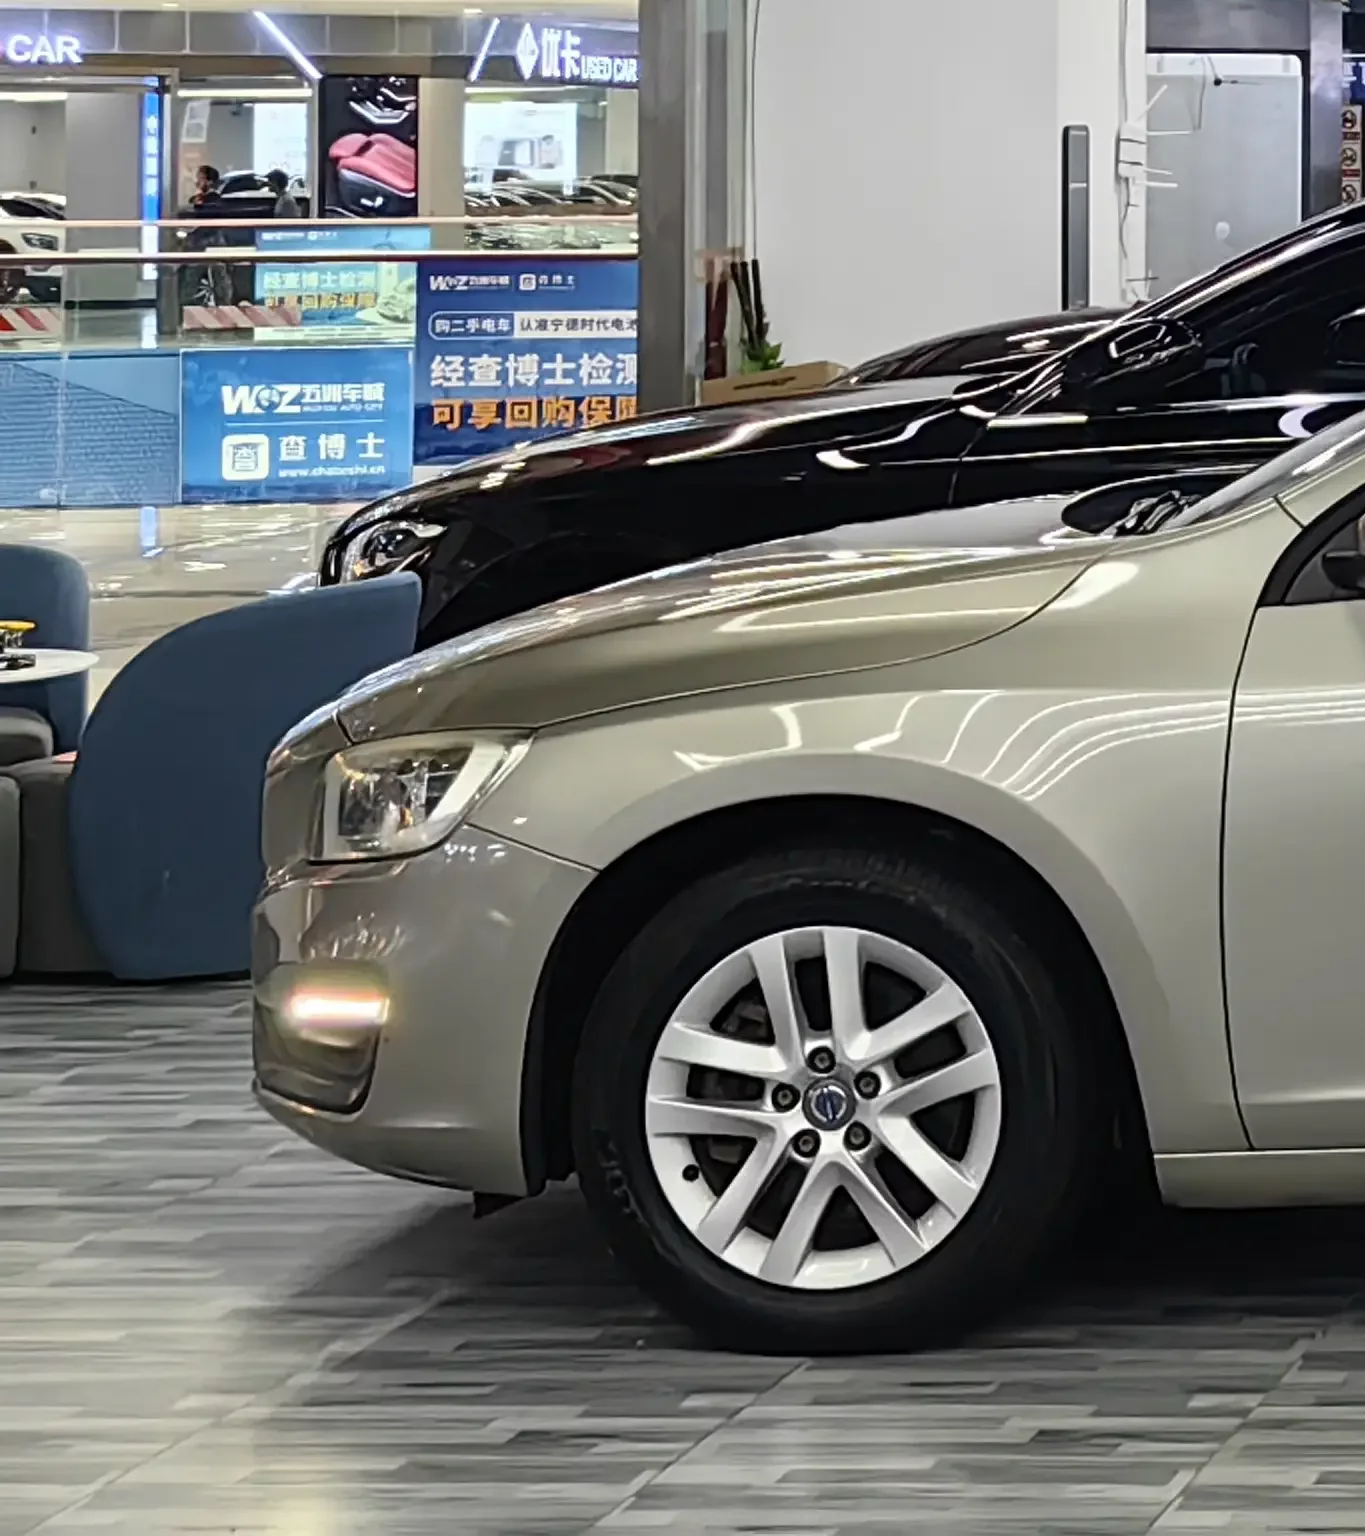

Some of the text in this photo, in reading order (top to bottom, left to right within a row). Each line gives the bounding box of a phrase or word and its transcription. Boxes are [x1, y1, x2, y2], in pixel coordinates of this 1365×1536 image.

[6, 34, 84, 64] CAR
[279, 432, 385, 462] 查博士
